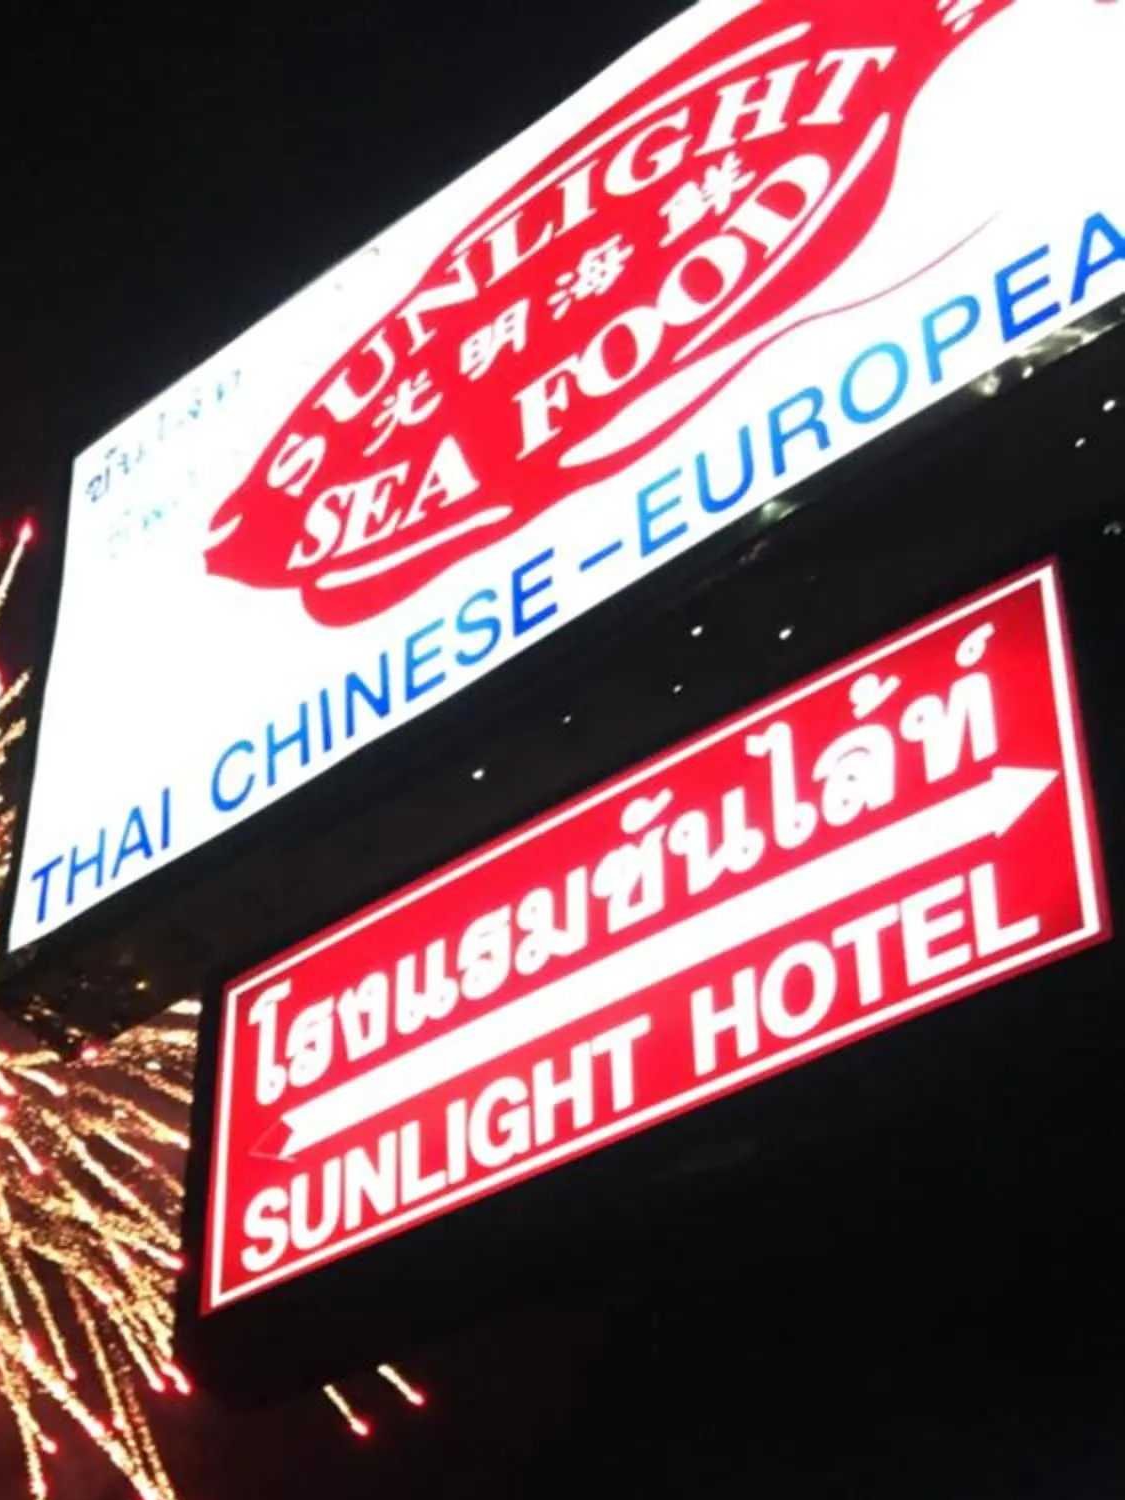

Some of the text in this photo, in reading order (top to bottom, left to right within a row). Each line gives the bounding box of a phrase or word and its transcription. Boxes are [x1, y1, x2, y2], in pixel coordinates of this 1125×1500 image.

[268, 47, 896, 492] SUNLIGHT
[287, 435, 479, 567] SEA
[513, 153, 832, 458] FOOD
[31, 788, 172, 924] THAI
[241, 863, 1040, 1273] SUNLIGHT HOTEL
